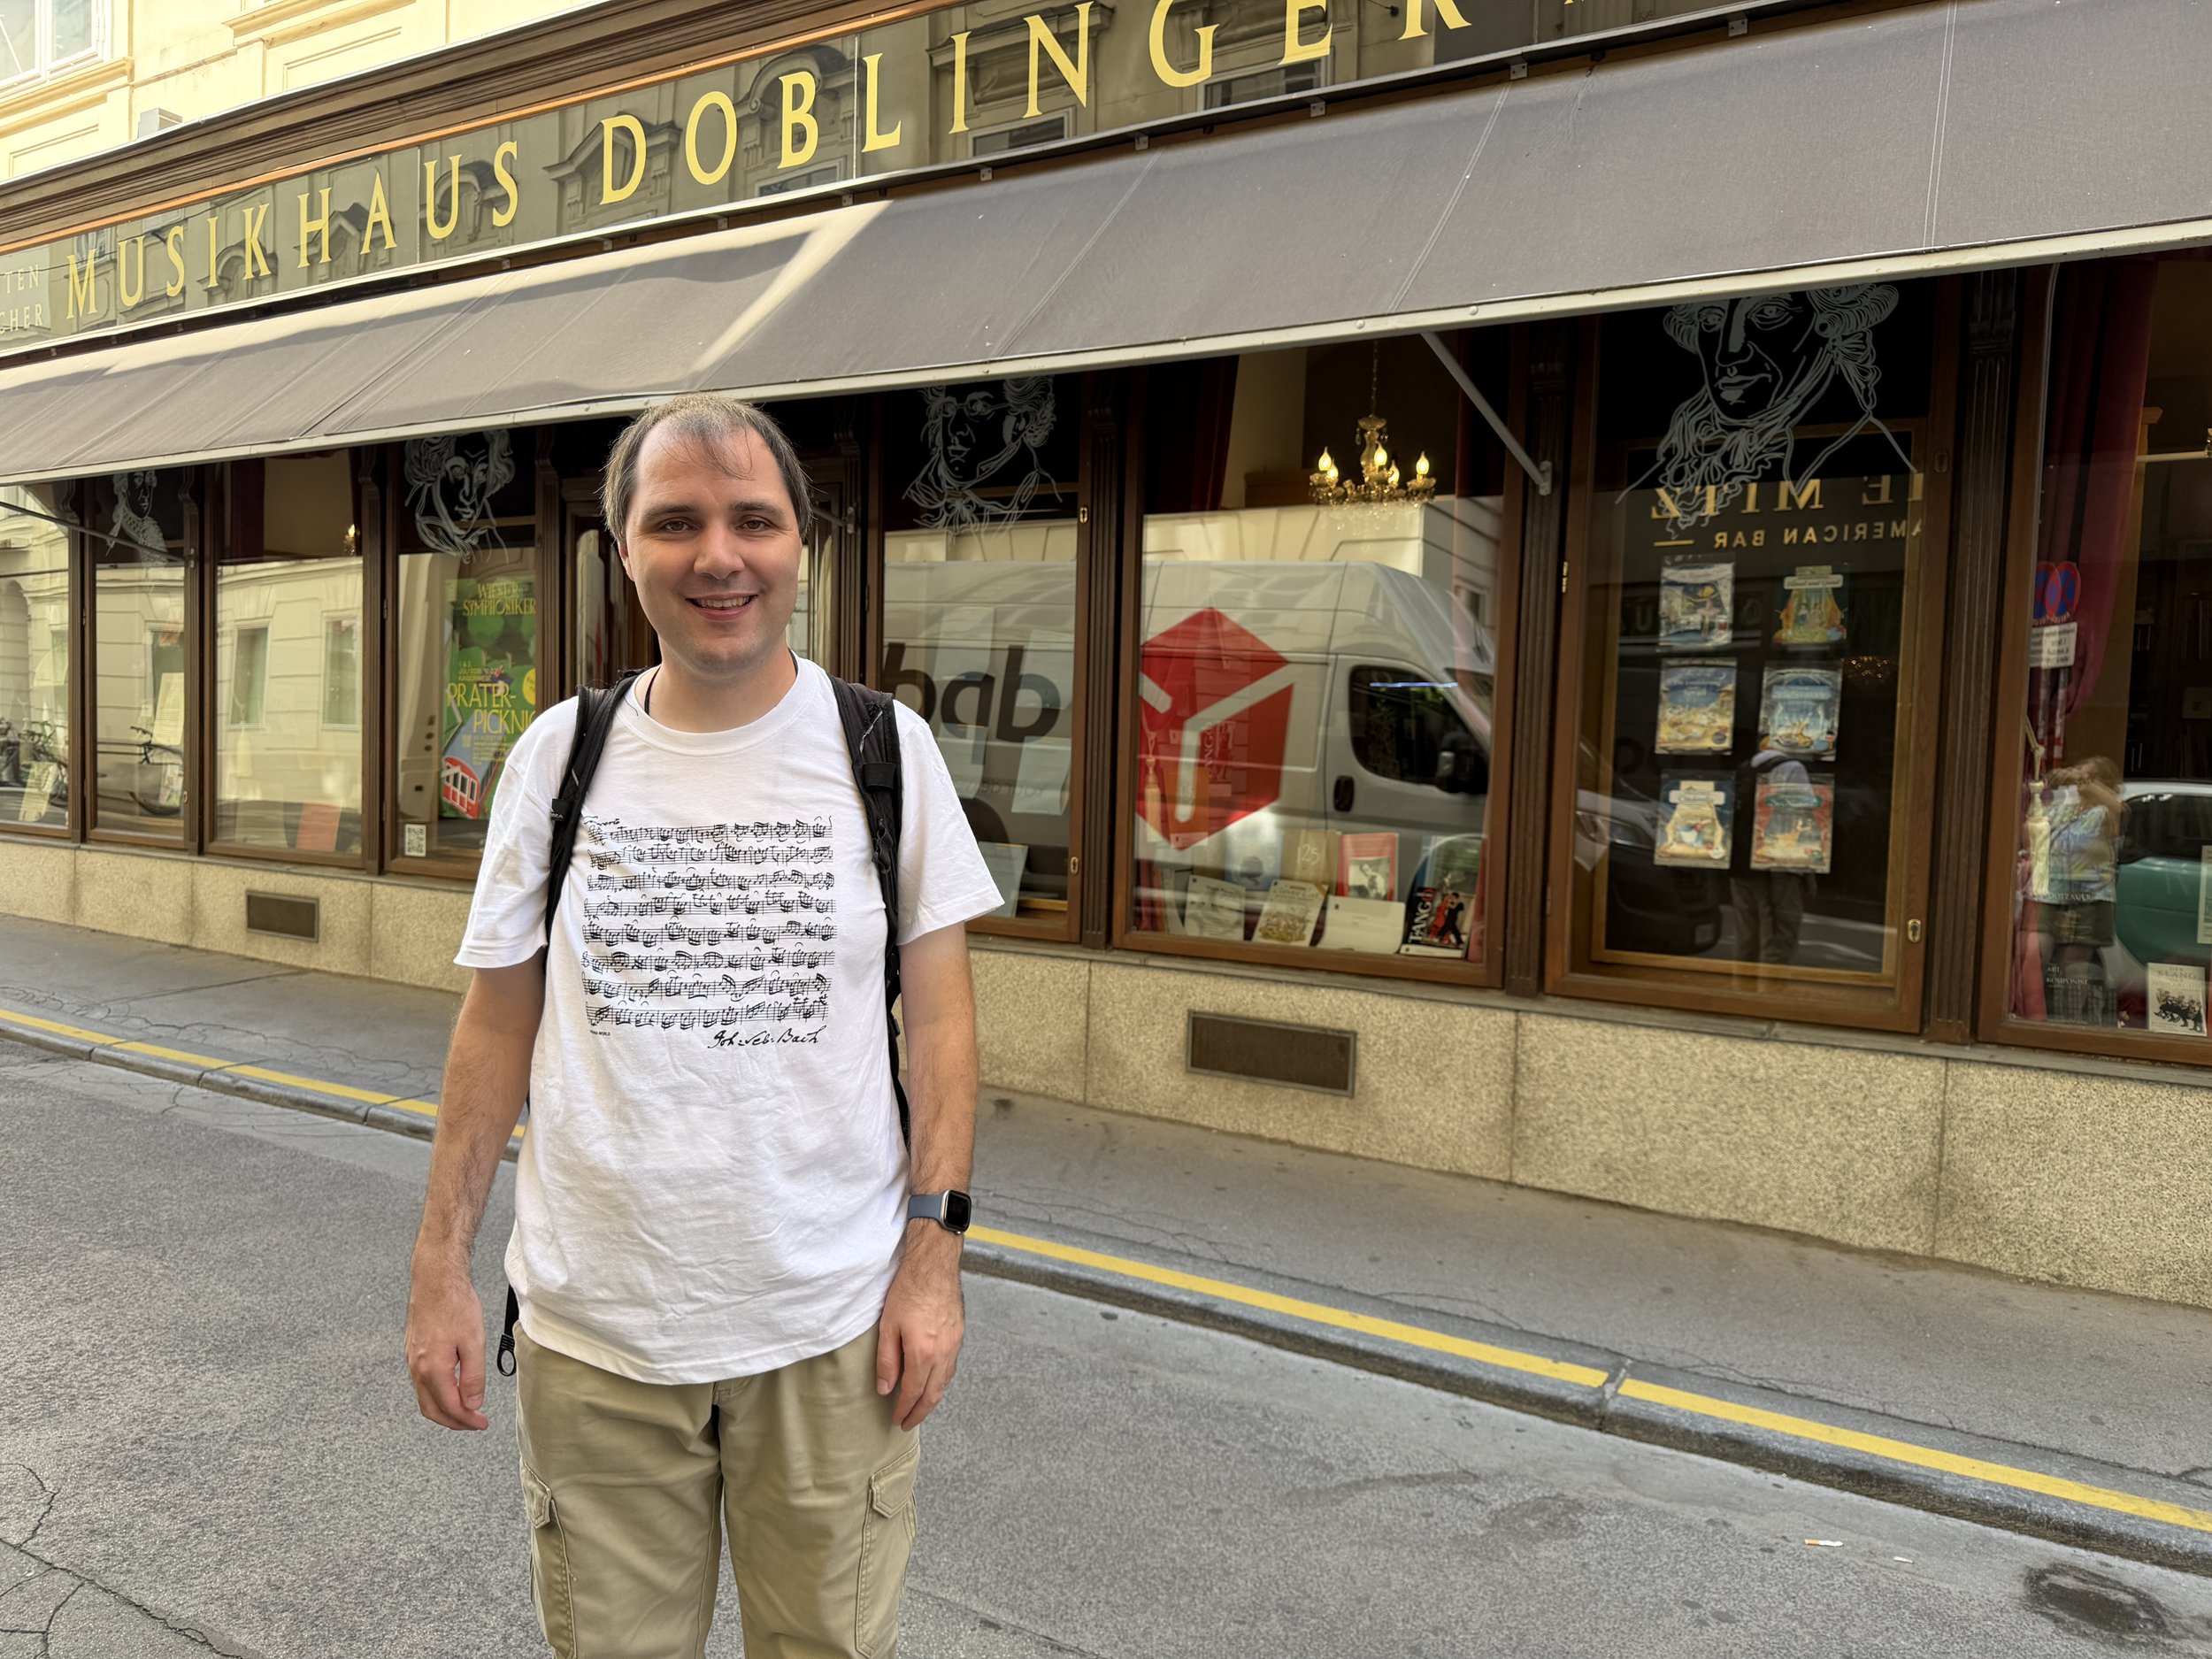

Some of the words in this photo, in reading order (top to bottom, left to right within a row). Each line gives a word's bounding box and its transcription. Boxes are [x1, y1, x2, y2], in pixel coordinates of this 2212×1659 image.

[65, 140, 518, 319] MUSIKHAUS
[479, 582, 519, 600] WIENER
[463, 597, 536, 617] SYMPHONIKER
[446, 682, 518, 709] PRATER-
[1297, 843, 1320, 866] 125
[1408, 887, 1436, 944] TANGO
